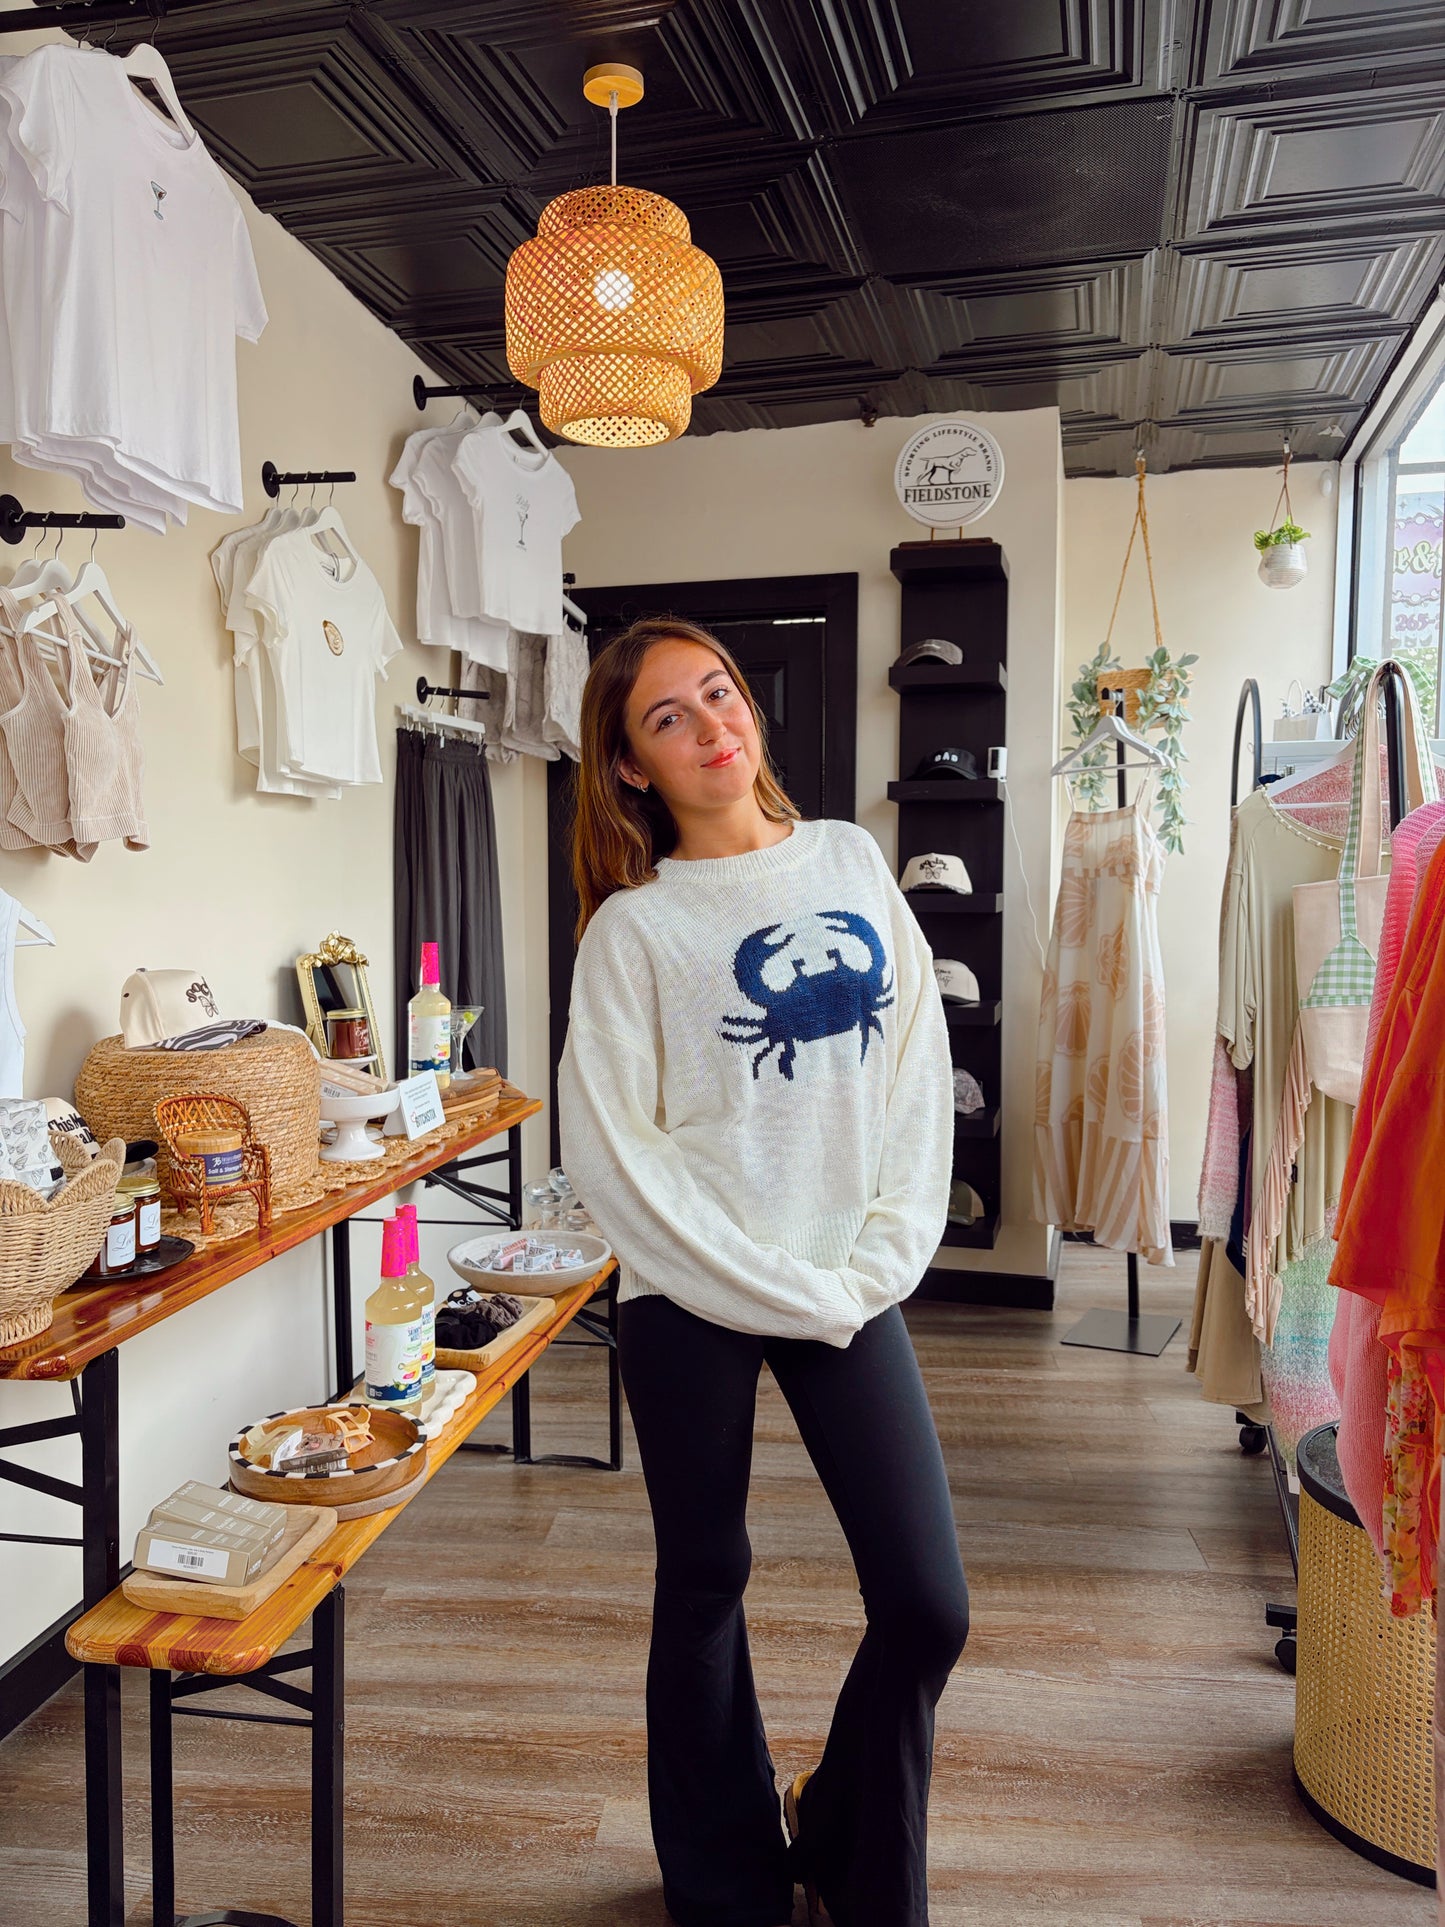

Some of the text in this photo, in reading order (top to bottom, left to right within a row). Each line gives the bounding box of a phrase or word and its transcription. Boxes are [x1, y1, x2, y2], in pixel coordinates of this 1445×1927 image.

[904, 428, 993, 477] SPORTING LIFESTYLE BRAND
[903, 483, 993, 504] FIELDSTONE
[934, 751, 959, 762] DAD
